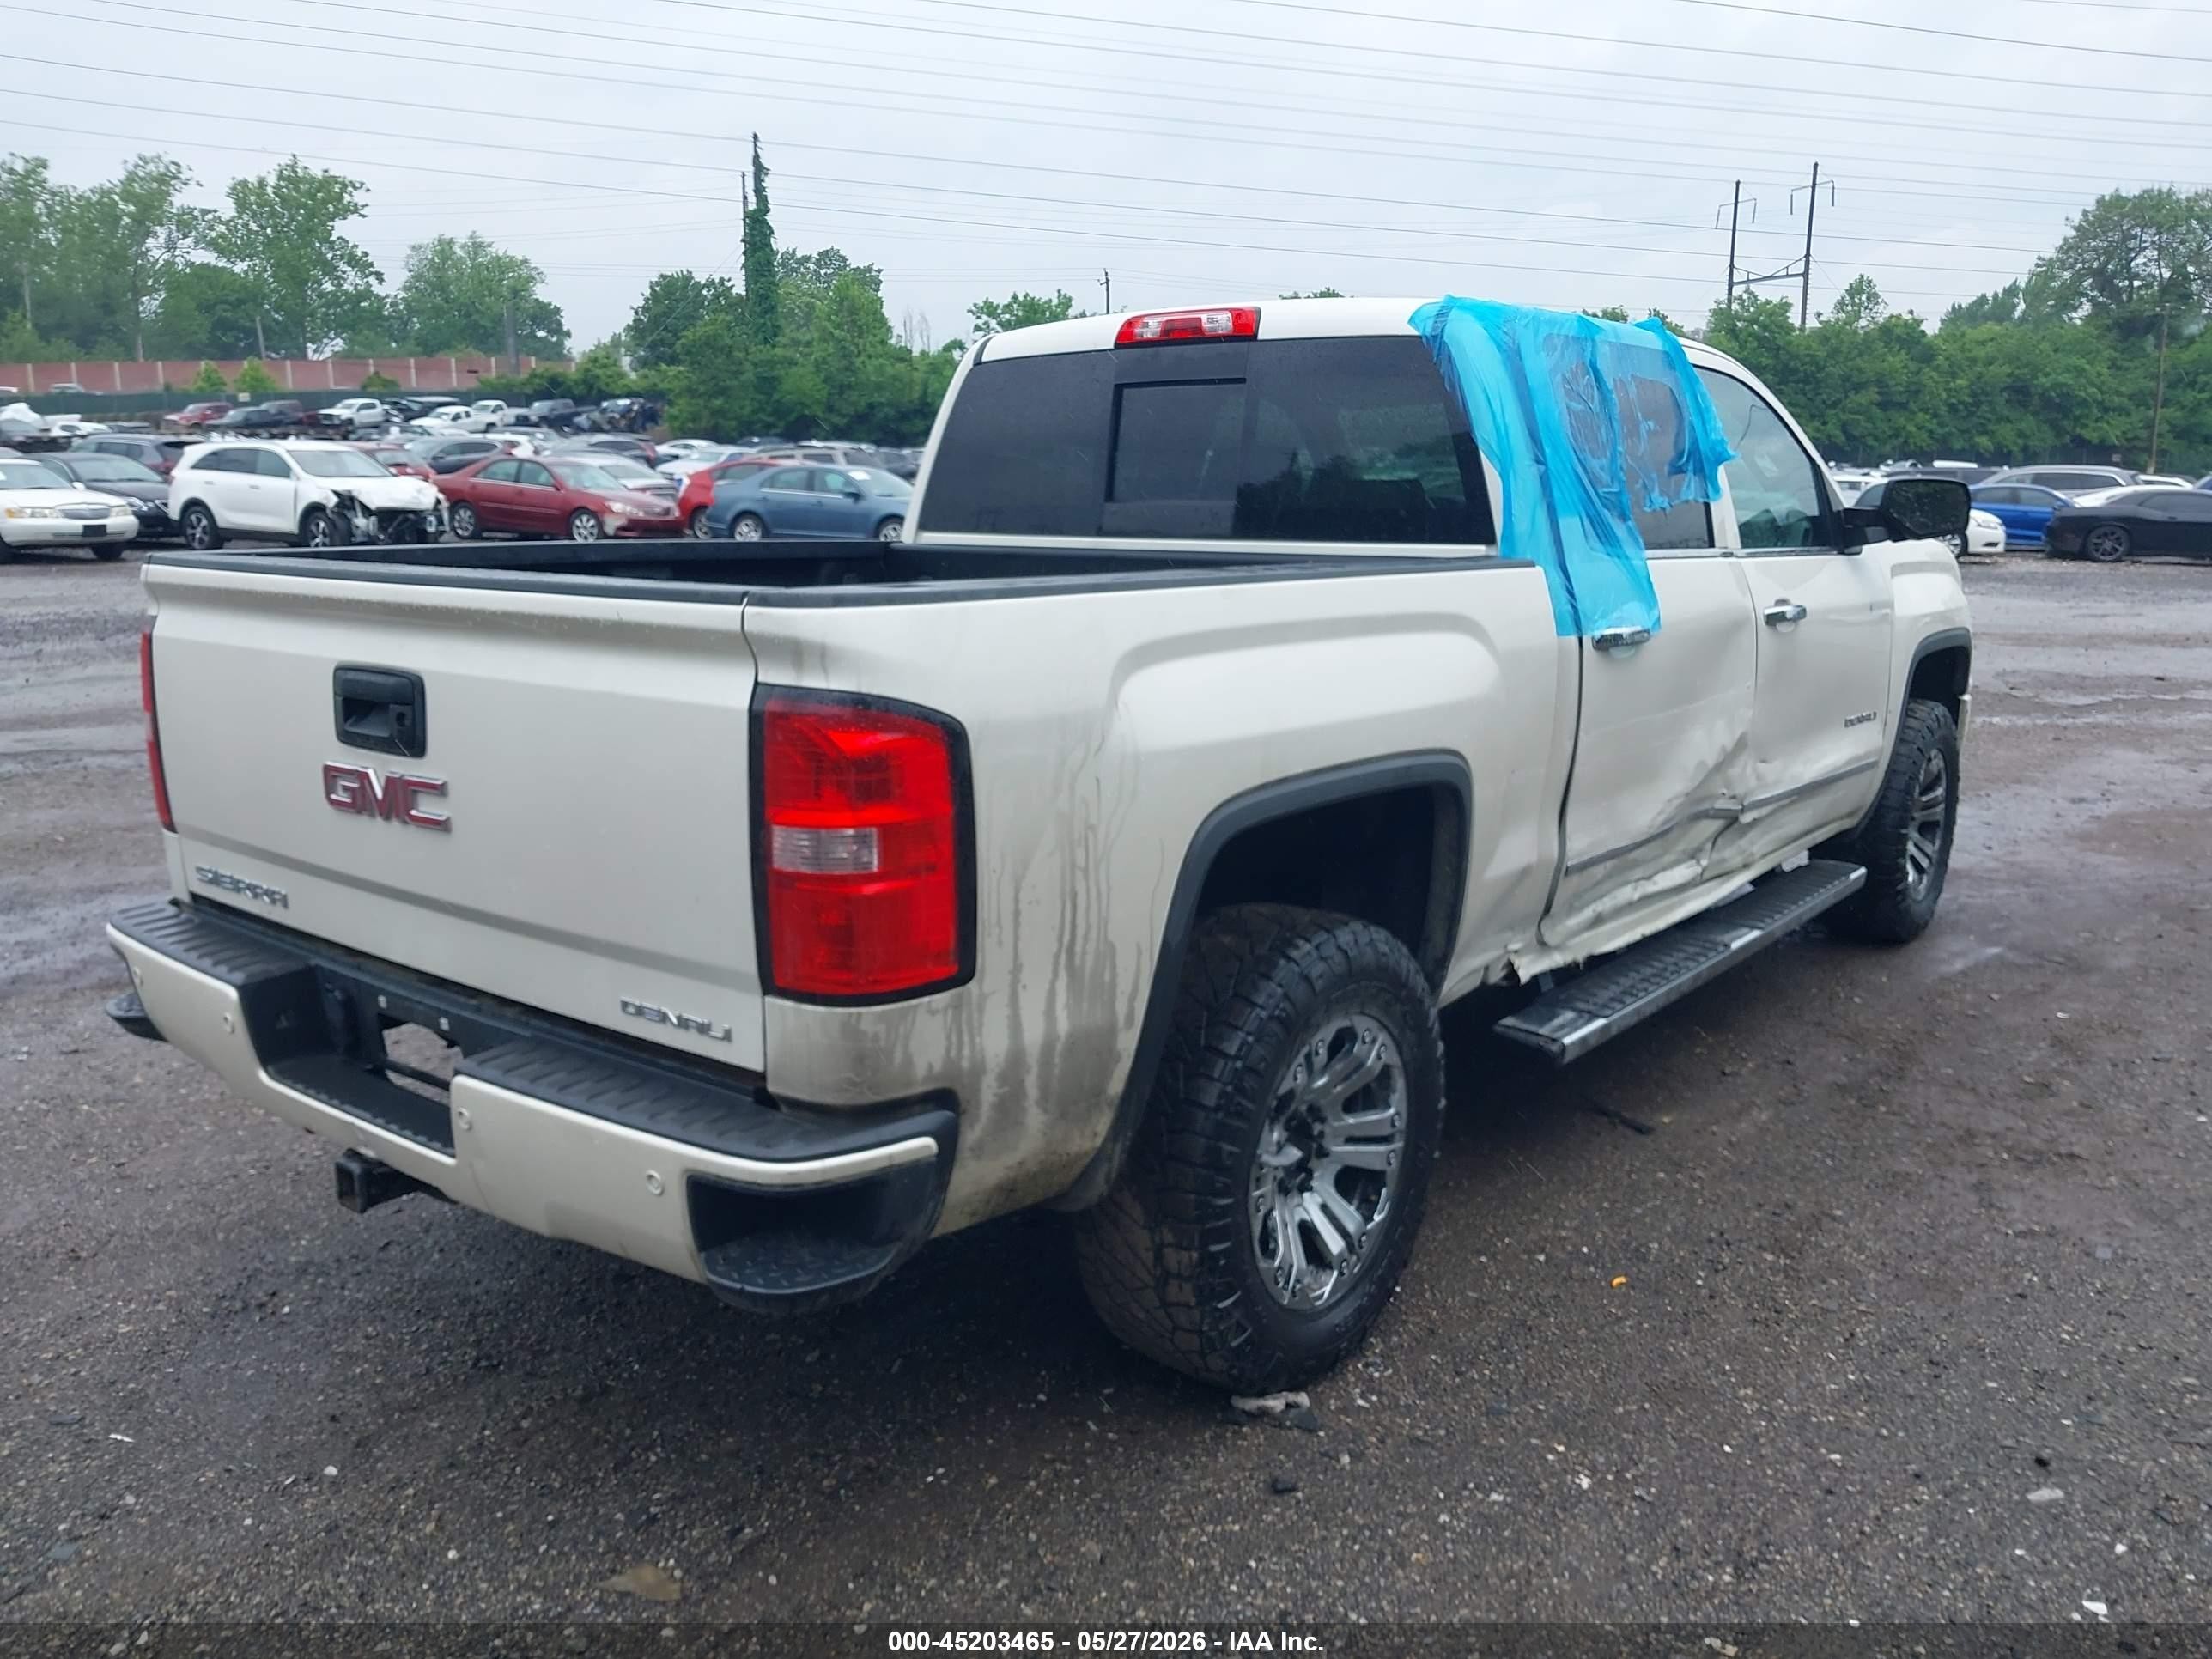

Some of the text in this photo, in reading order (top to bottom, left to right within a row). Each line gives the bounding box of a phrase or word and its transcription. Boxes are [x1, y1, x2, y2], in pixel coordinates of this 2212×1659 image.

[323, 761, 453, 833] GMC
[195, 865, 289, 910] SIERRA
[619, 995, 732, 1044] DENALI
